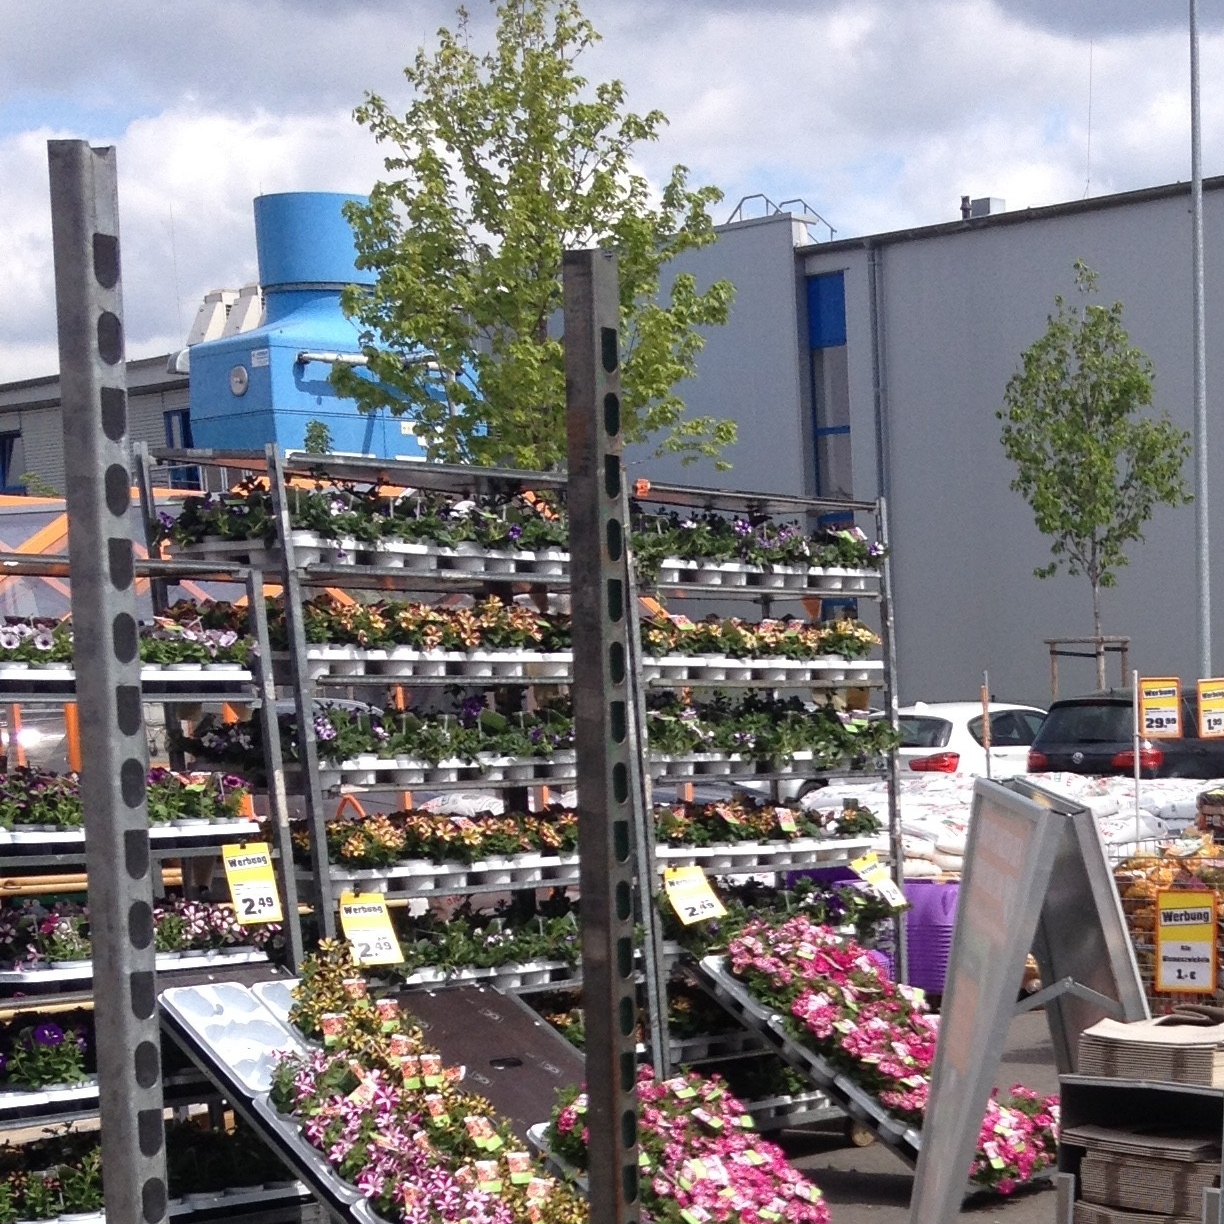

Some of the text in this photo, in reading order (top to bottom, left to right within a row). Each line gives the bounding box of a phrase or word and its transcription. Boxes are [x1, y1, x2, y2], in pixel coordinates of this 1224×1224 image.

[227, 855, 268, 868] Werbung
[343, 904, 384, 915] Werbung
[1162, 910, 1210, 923] Werbung
